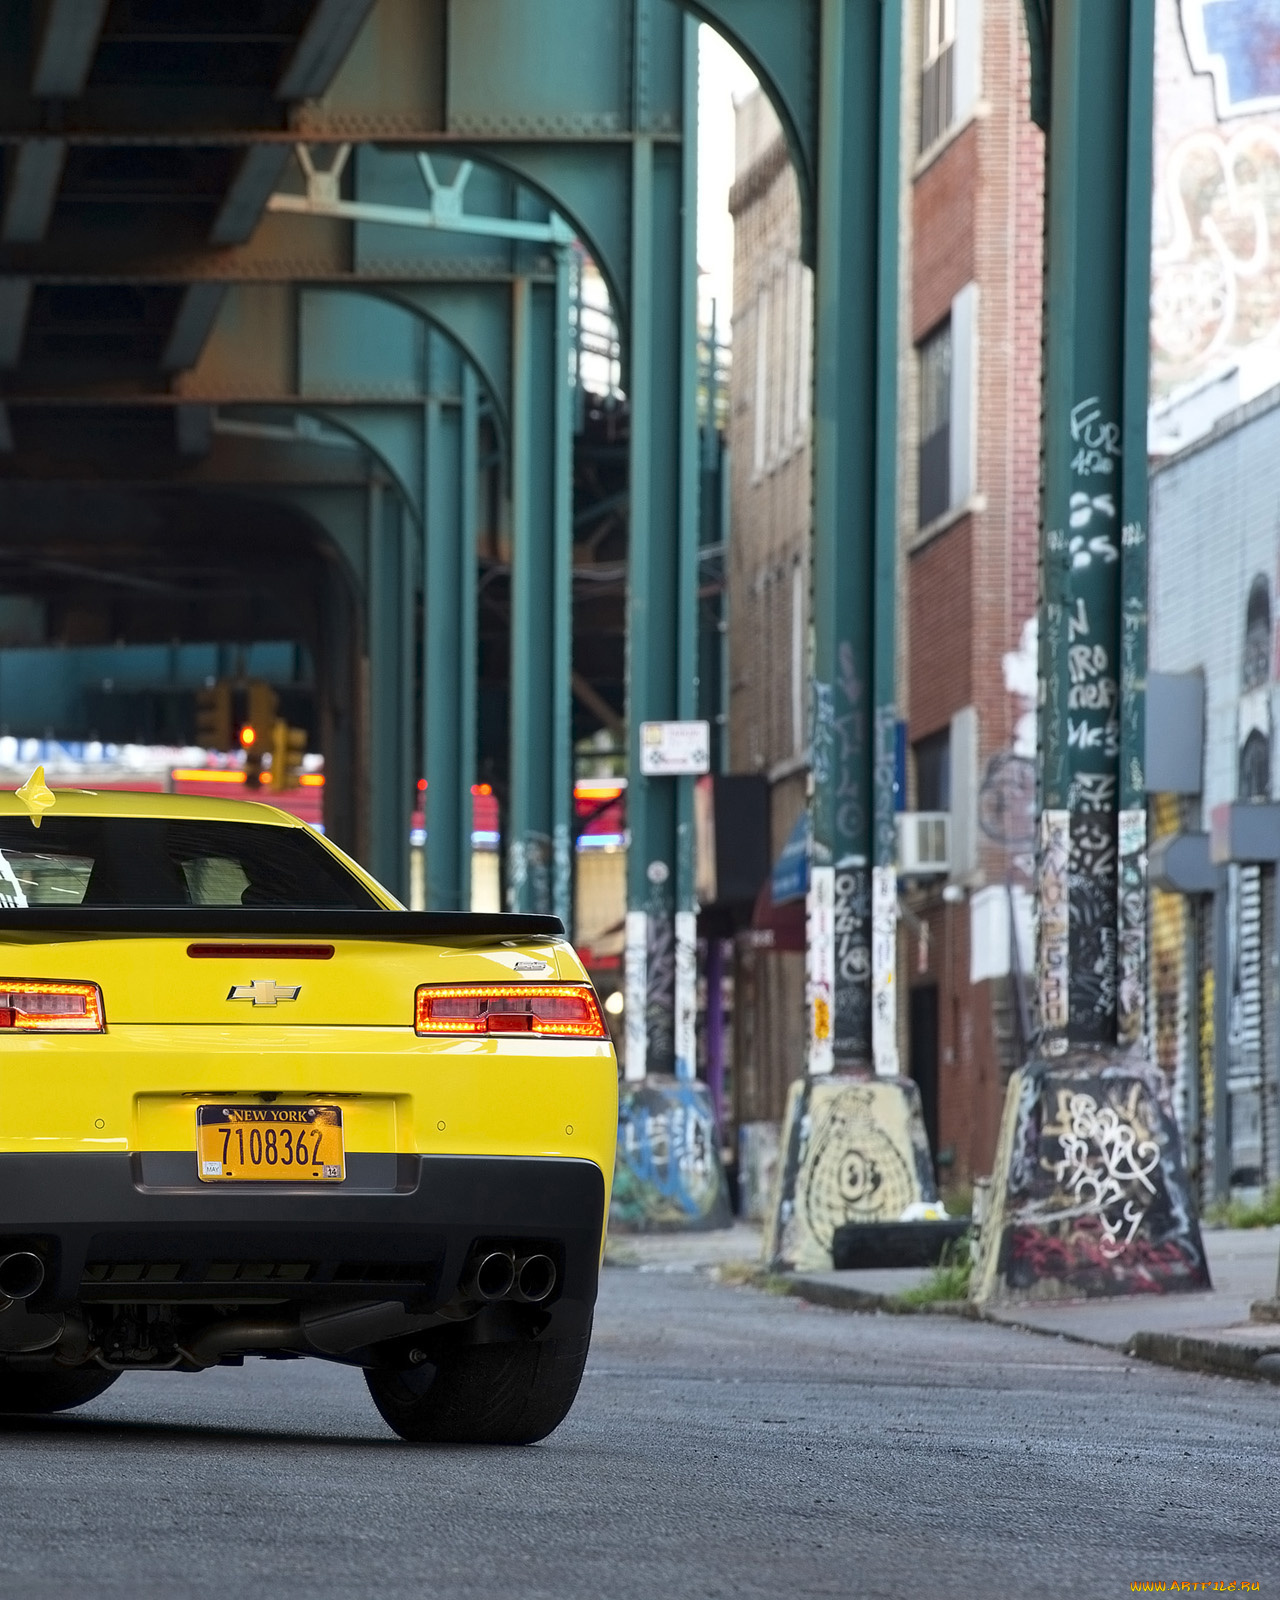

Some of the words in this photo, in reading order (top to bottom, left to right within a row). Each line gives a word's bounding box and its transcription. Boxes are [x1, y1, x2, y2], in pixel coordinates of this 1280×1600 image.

[233, 1110, 267, 1122] NEW
[270, 1110, 308, 1122] YORK
[218, 1128, 325, 1166] 7108362
